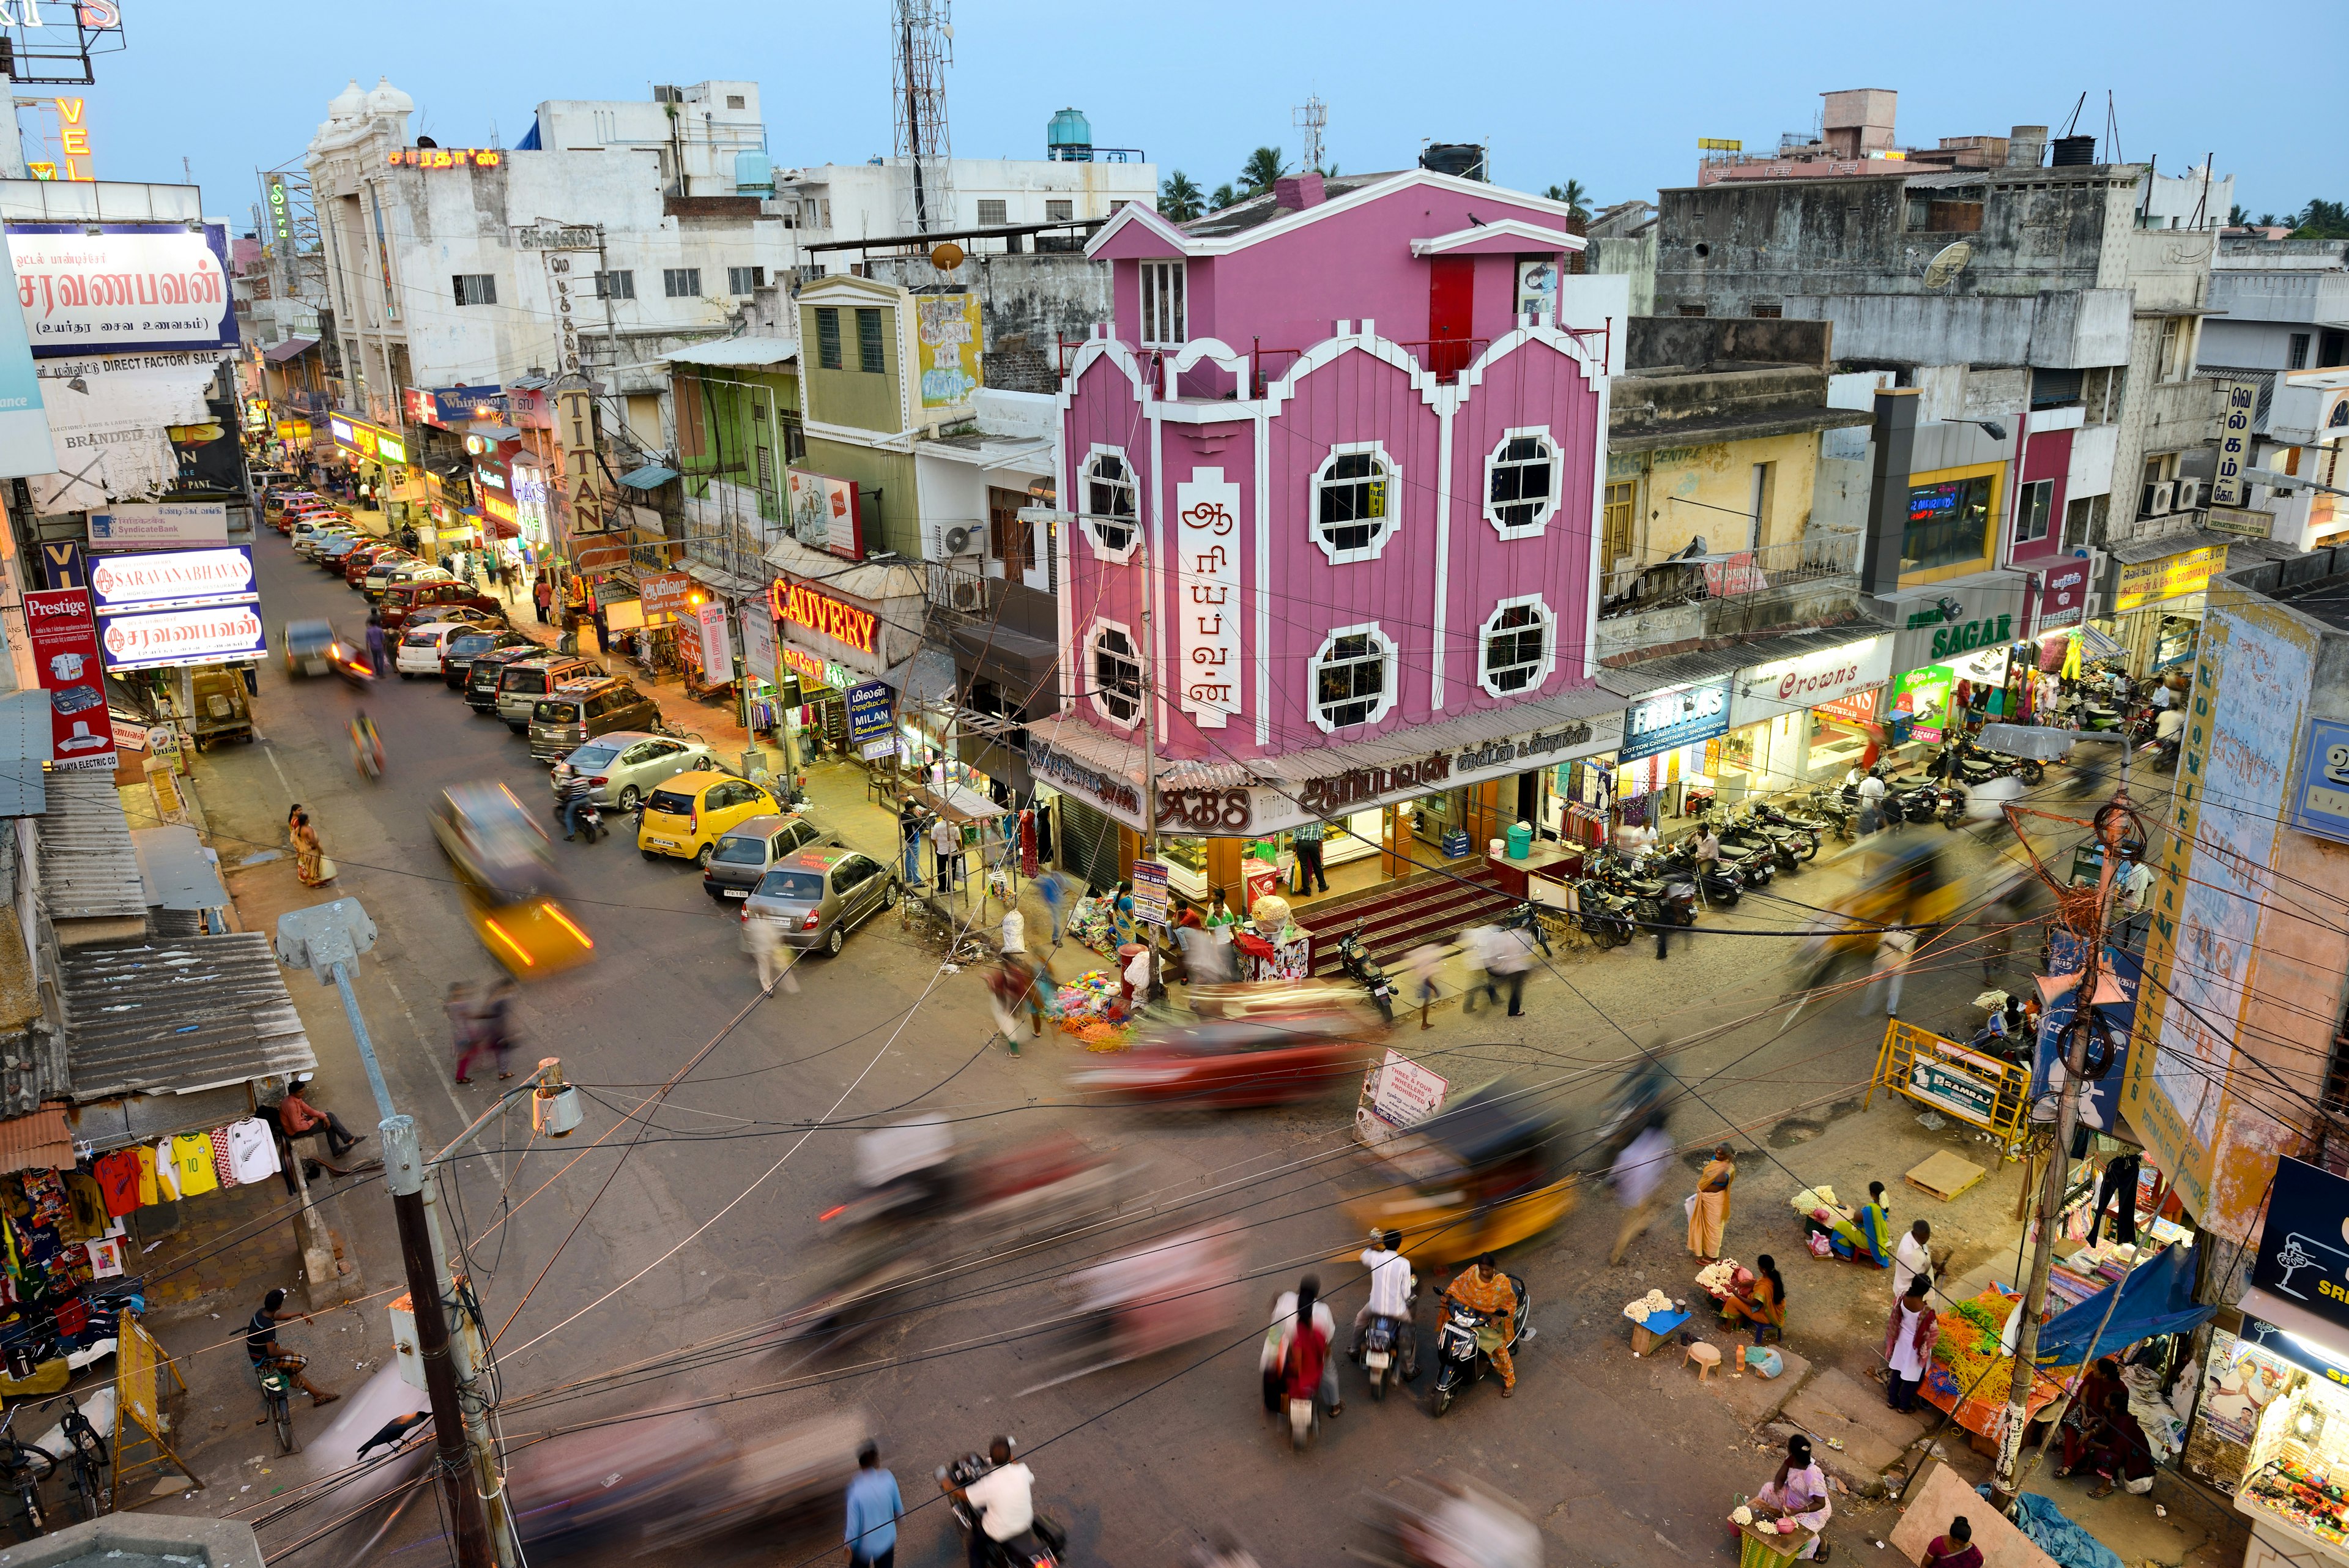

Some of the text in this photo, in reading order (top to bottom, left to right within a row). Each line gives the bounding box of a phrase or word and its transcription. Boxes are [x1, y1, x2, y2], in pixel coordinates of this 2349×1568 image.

[18, 259, 222, 318] சரவணபவன்
[103, 352, 220, 371] DIRECT FACTORY SALE
[443, 396, 500, 409] Whirlpool
[65, 429, 143, 449] BRANDED
[2220, 387, 2252, 477] வெல்கம்
[561, 391, 602, 532] TITAN
[188, 480, 210, 489] PANT
[833, 497, 845, 508] Hanes
[2210, 520, 2265, 534] DEPARTMENTAL STORE
[2211, 510, 2249, 524] GOODMAN
[2178, 551, 2208, 567] WELCOME
[2216, 547, 2225, 558] CO.
[115, 562, 250, 587] SARAVANABHAVAN
[2153, 578, 2158, 589] &
[2176, 567, 2206, 584] GOODMAN
[2208, 565, 2213, 574] &
[28, 598, 86, 617] Prestige
[773, 578, 875, 653] CAUVERY
[2041, 607, 2081, 629] FADEEN'S
[127, 614, 257, 648] சரவணபவன்
[1932, 613, 2012, 659] SAGAR
[784, 648, 823, 680] காவேரி
[1779, 661, 1858, 699] Crown's
[1866, 680, 1885, 689] Wear
[1912, 681, 1949, 693] school items
[852, 686, 886, 703] மிலன்
[855, 710, 888, 726] MILAN
[1819, 704, 1857, 719] FOOTWEAR
[855, 722, 892, 735] Readymades
[1622, 721, 1726, 754] COTTON CHUDITHAR SHOW ROOM
[1654, 723, 1696, 739] LADY'S WEAR
[1517, 741, 1530, 758] &
[79, 758, 107, 768] ELECTRIC
[108, 756, 116, 765] CO
[1155, 789, 1252, 833] ABS
[2197, 818, 2263, 893] SHARP
[1391, 1066, 1409, 1081] THREE
[1416, 1080, 1432, 1093] FOUR
[1395, 1076, 1425, 1097] WHEELERS
[1391, 1082, 1425, 1105] PROHIBITED
[1944, 1078, 1991, 1104] RAMRAJ
[1950, 1091, 1972, 1105] COTTON
[2148, 1088, 2162, 1117] M.G.
[1375, 1107, 1403, 1127] Traffic Police
[2141, 1108, 2164, 1150] PERUMAL
[186, 1157, 198, 1173] 10
